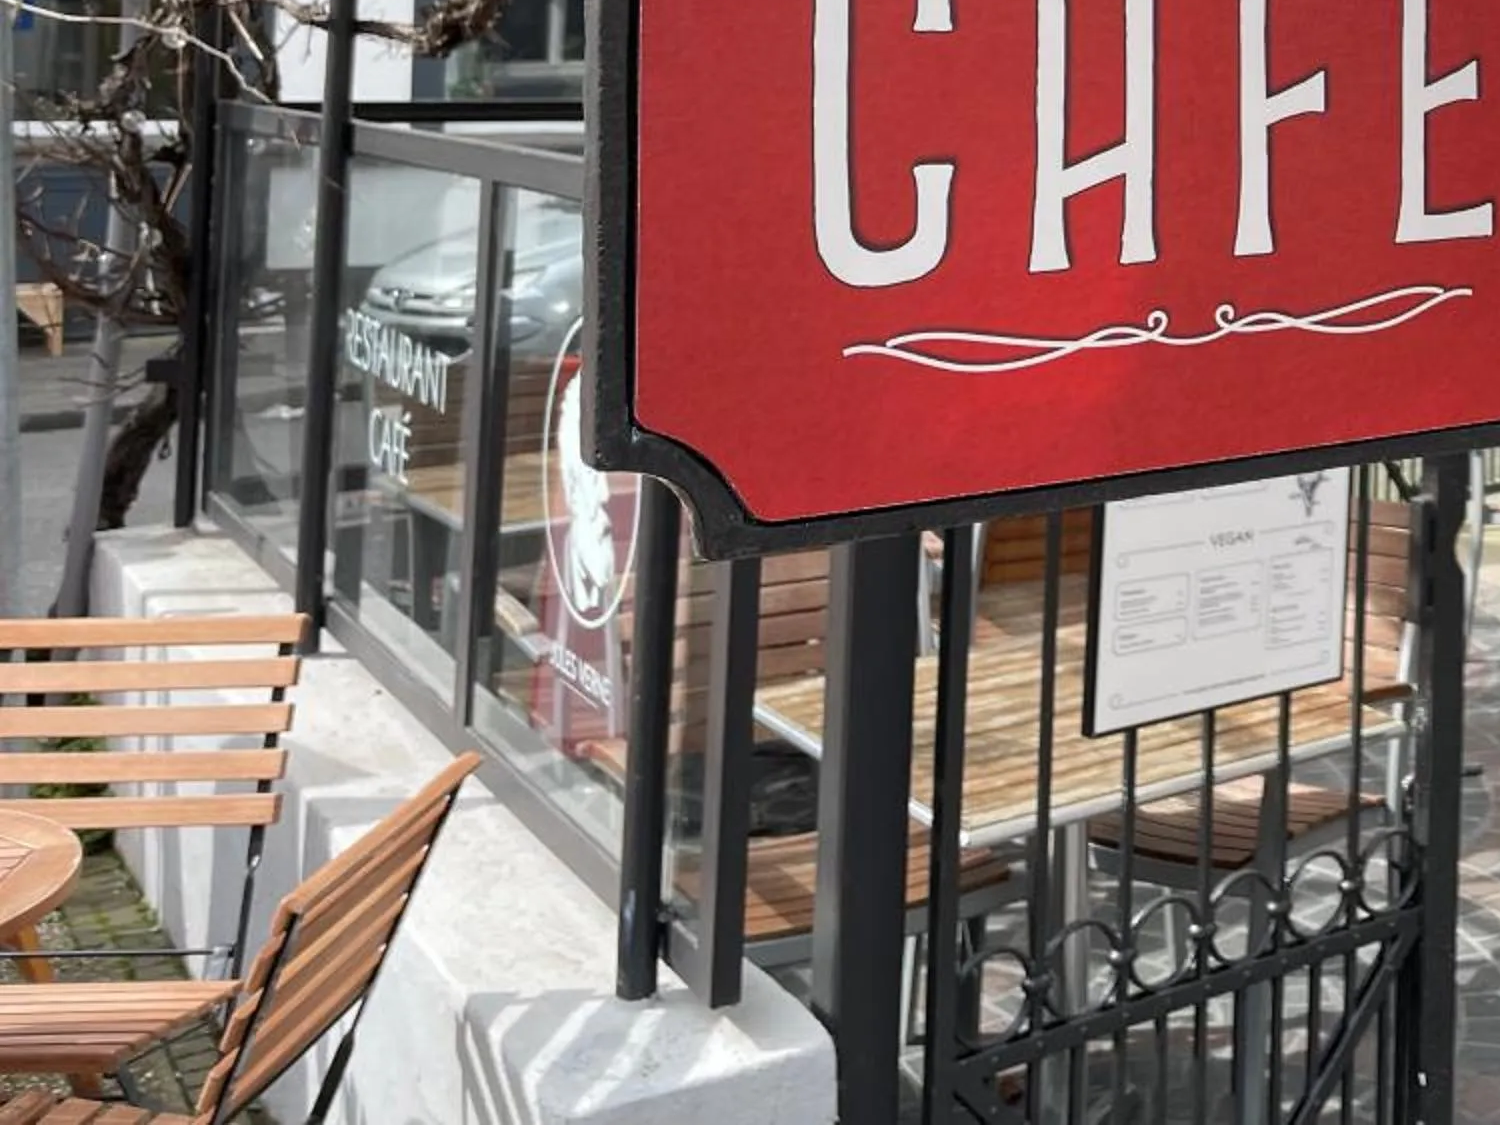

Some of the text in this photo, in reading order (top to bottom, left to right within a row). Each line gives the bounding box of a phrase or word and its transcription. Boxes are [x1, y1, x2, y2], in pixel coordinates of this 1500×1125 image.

[346, 308, 450, 415] RESTAURANT
[368, 408, 413, 487] CAFÉ
[1208, 530, 1254, 548] VEGAN
